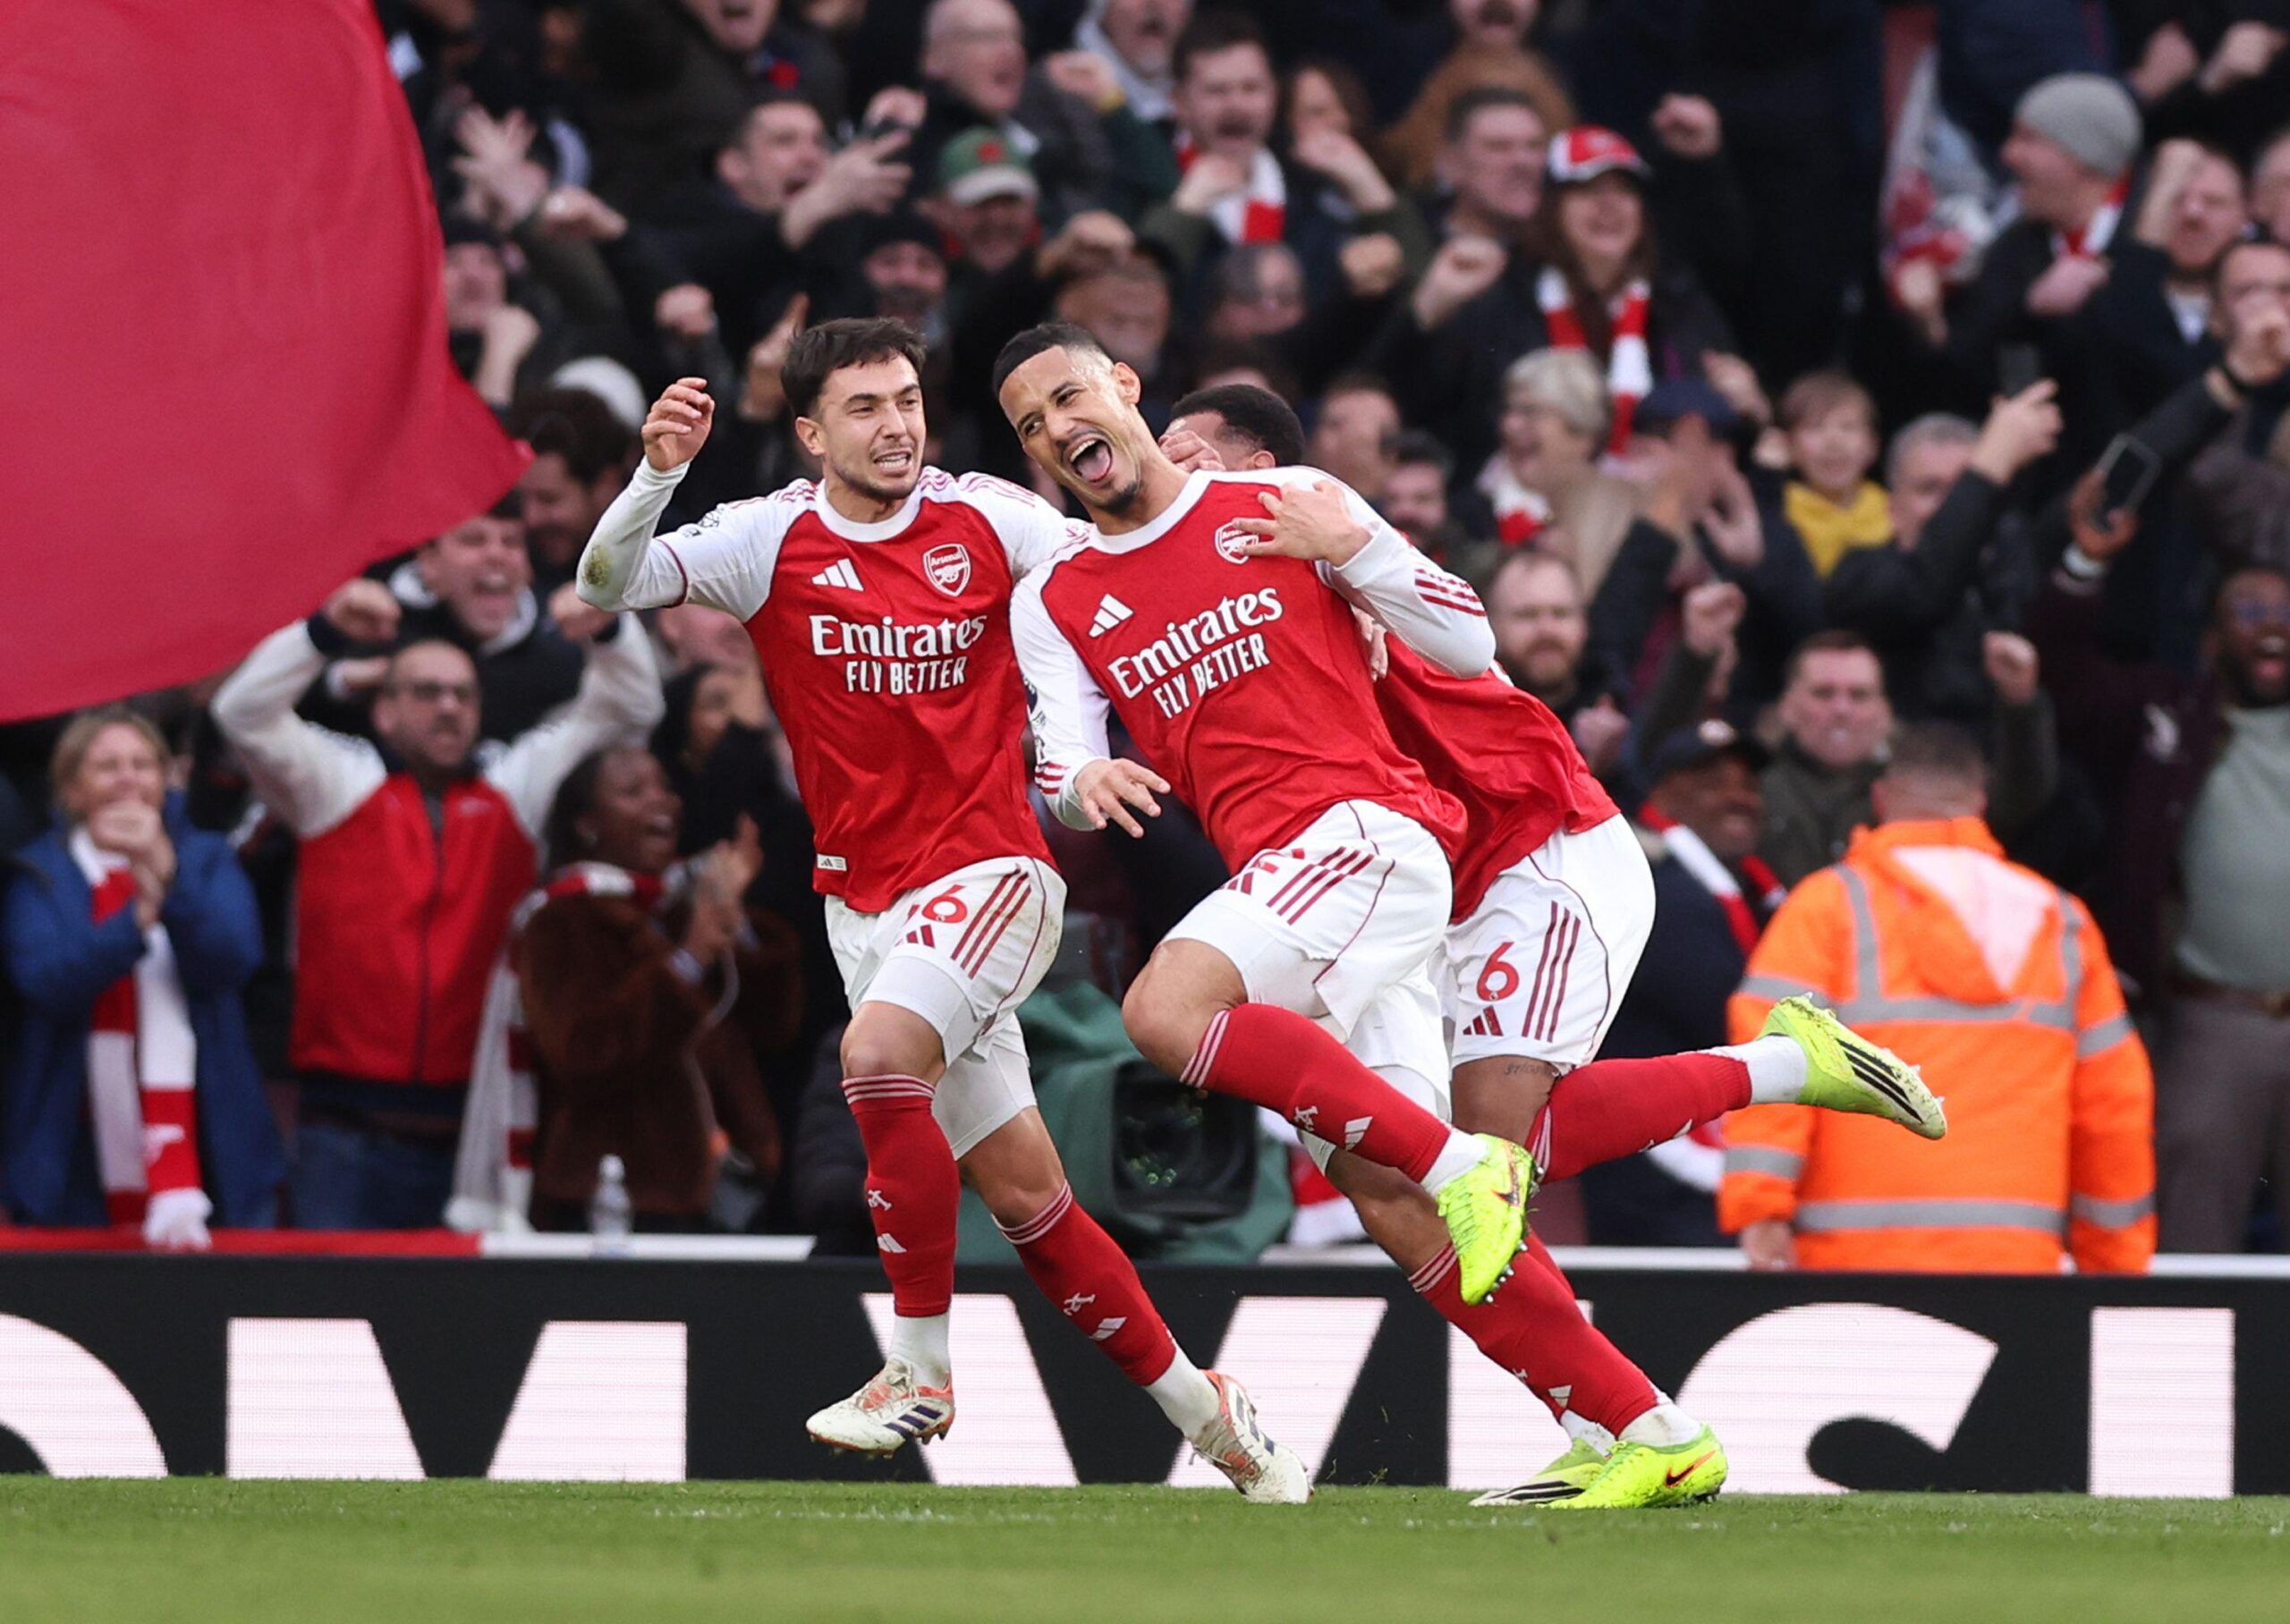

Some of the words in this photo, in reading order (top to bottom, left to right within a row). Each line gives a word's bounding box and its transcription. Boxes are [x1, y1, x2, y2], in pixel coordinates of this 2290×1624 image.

[810, 614, 988, 658] Emirates
[1107, 588, 1283, 699] Emirates
[846, 660, 882, 693] FLY
[890, 656, 968, 695] BETTER
[1152, 672, 1191, 719] FLY
[1191, 633, 1270, 698] BETTER
[1476, 942, 1520, 1002] 6
